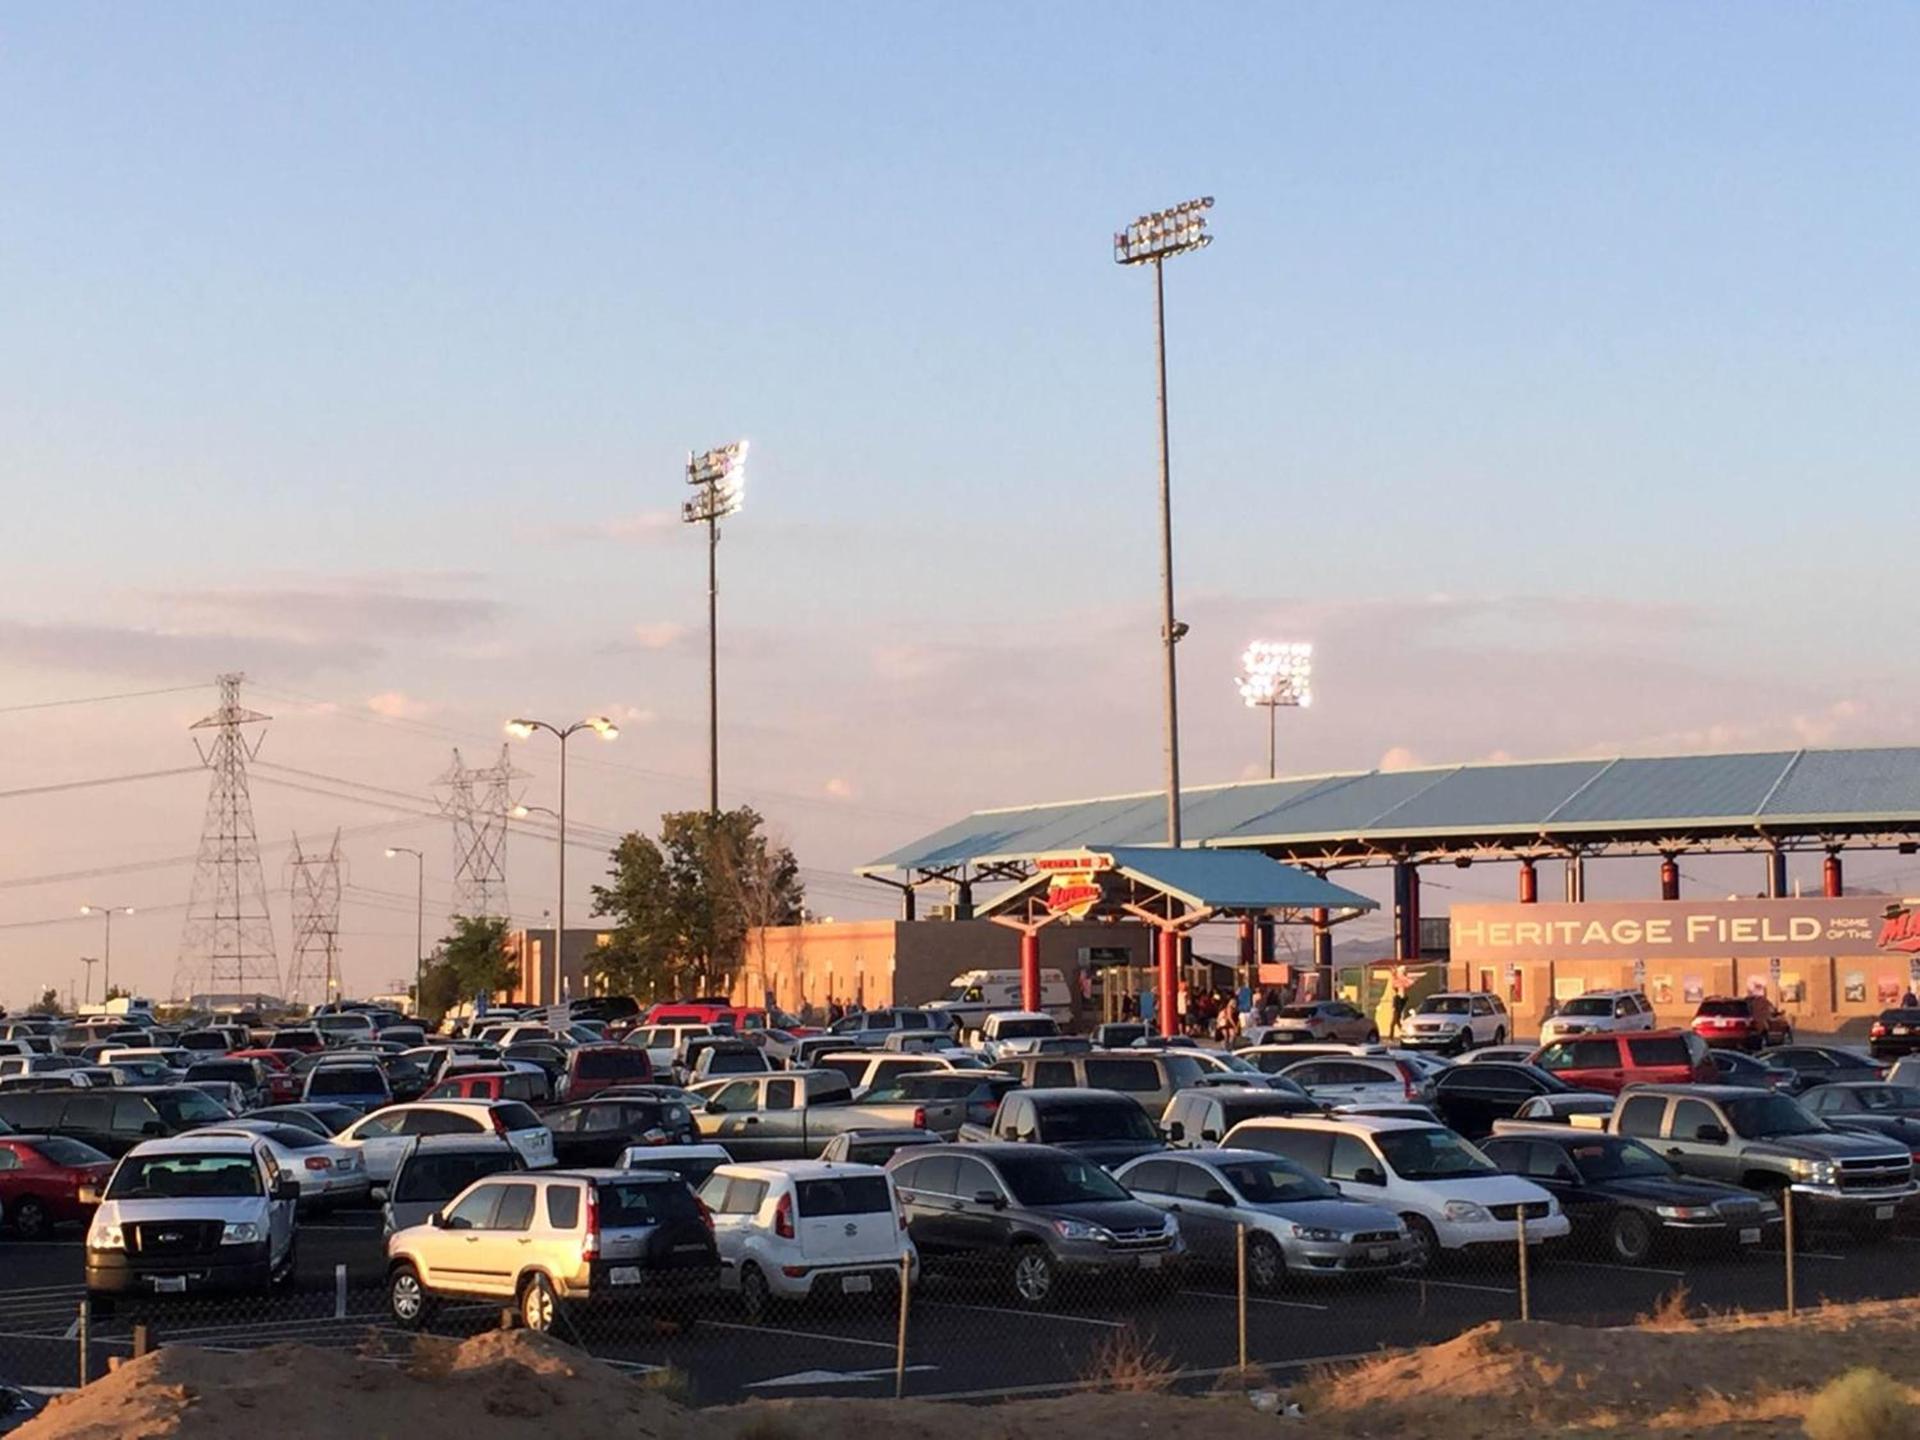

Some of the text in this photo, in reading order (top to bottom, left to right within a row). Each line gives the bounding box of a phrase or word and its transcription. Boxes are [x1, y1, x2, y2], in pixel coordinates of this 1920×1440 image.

[1830, 918, 1868, 927] HOME
[1455, 915, 1822, 946] HERITAGE FIELD
[1826, 929, 1872, 939] OF THE
